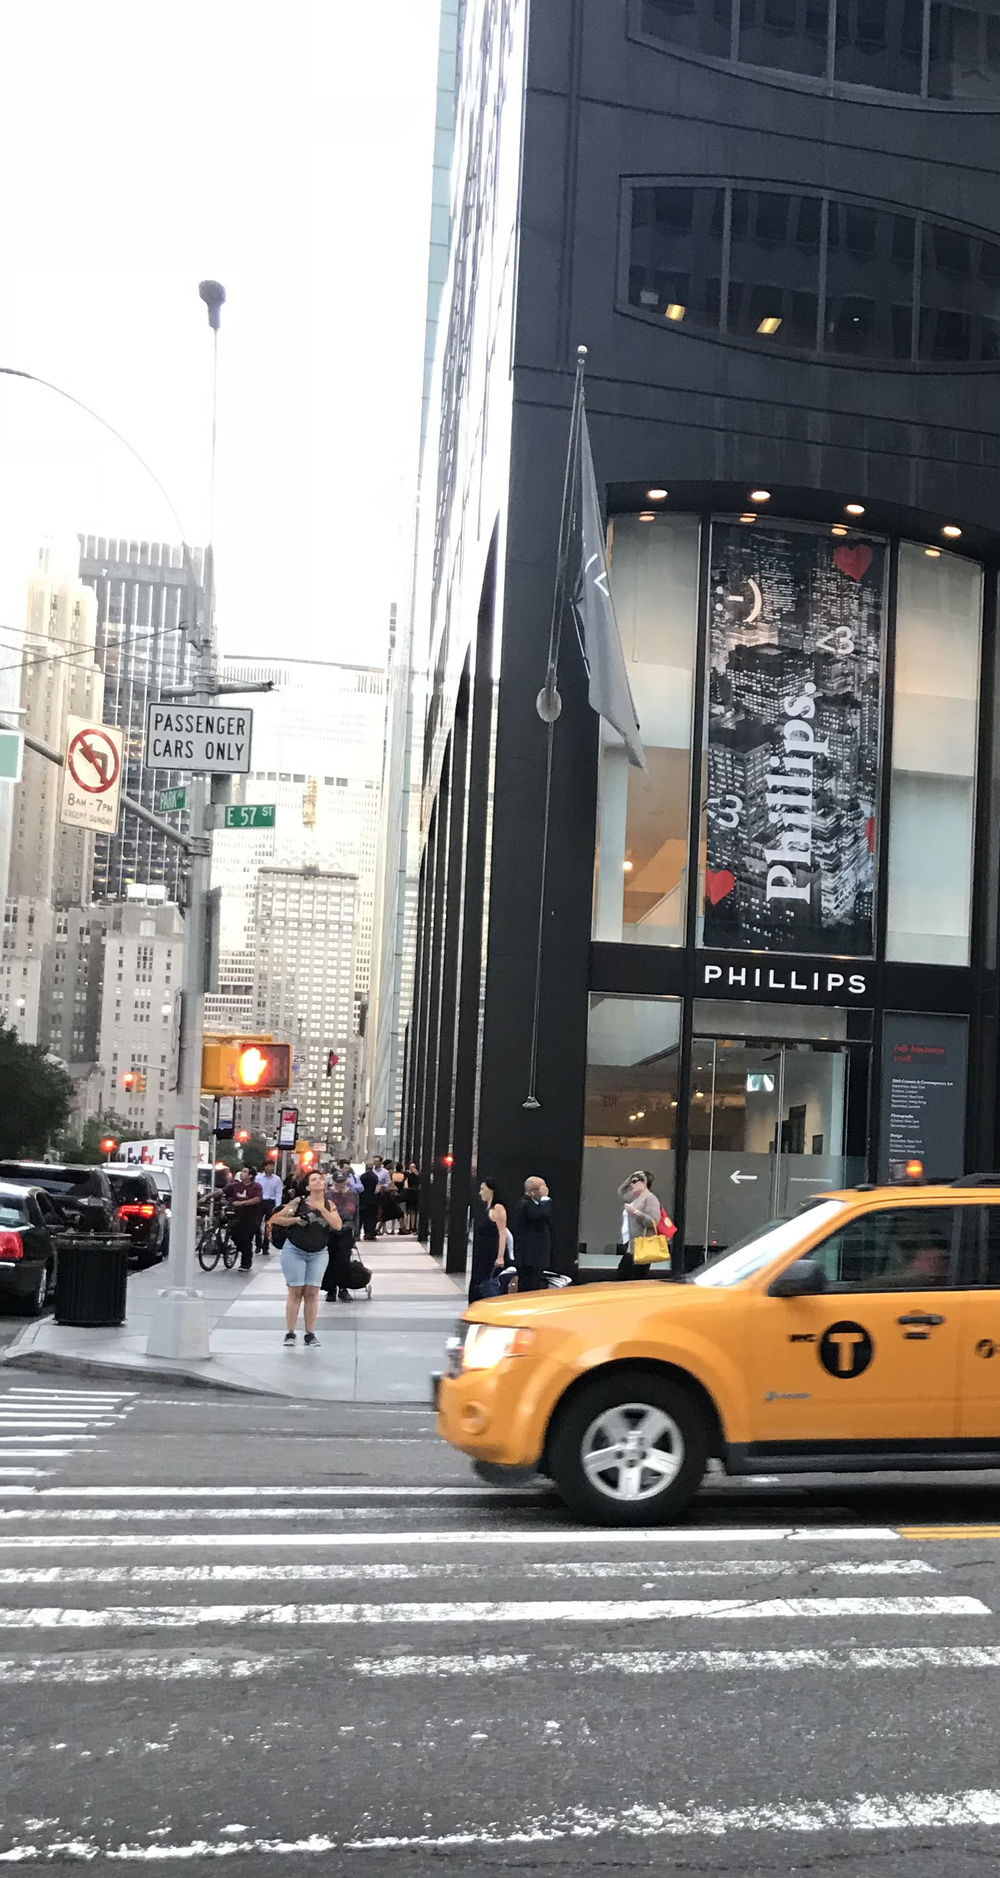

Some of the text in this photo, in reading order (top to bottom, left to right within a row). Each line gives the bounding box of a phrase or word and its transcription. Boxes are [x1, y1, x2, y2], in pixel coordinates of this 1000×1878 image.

[154, 713, 246, 736] PASSENGER
[153, 739, 245, 761] CARS ONLY
[161, 790, 176, 810] PARK
[227, 806, 274, 826] E 57 ST
[704, 964, 867, 994] PHILLIPS
